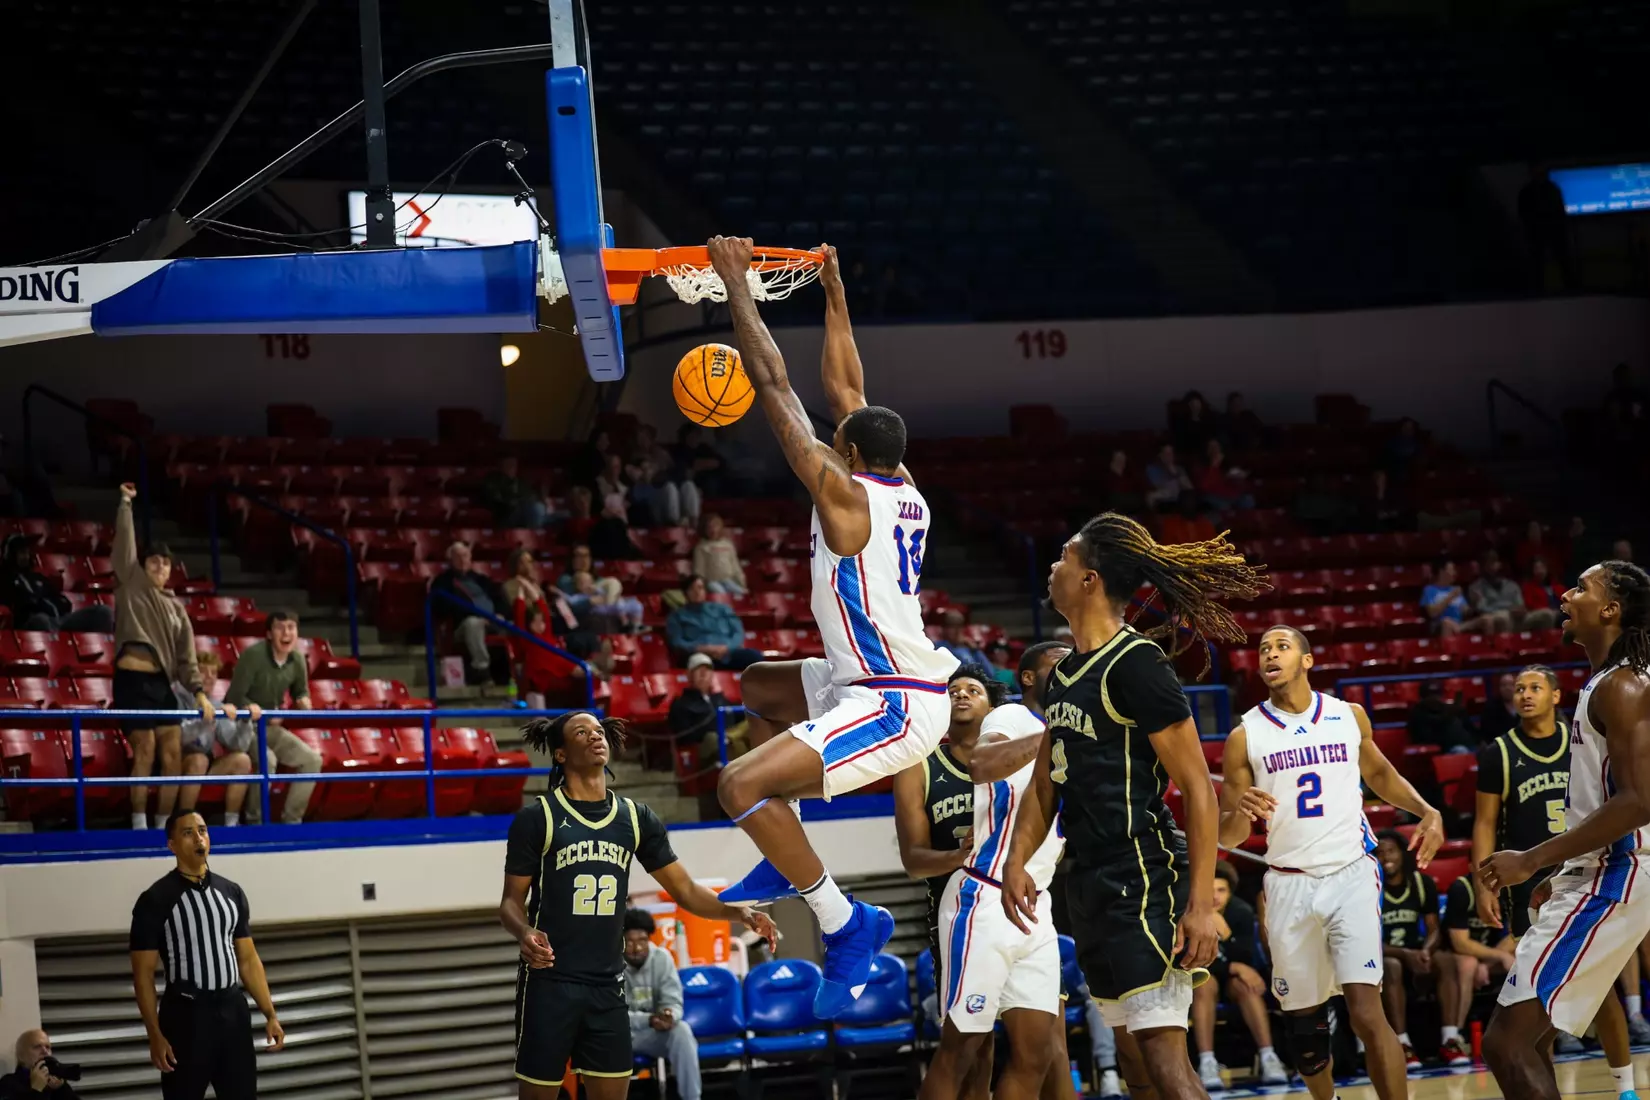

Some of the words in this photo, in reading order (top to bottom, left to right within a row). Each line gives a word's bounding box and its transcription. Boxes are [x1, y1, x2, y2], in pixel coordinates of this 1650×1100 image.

[258, 334, 311, 360] 118
[1015, 328, 1068, 359] 119
[893, 524, 925, 595] 14
[1263, 745, 1320, 774] LOUISIANA
[1320, 743, 1348, 763] TECH
[932, 793, 974, 824] ECCL
[1297, 771, 1324, 818] 2
[1546, 799, 1567, 834] 5
[572, 874, 617, 916] 22
